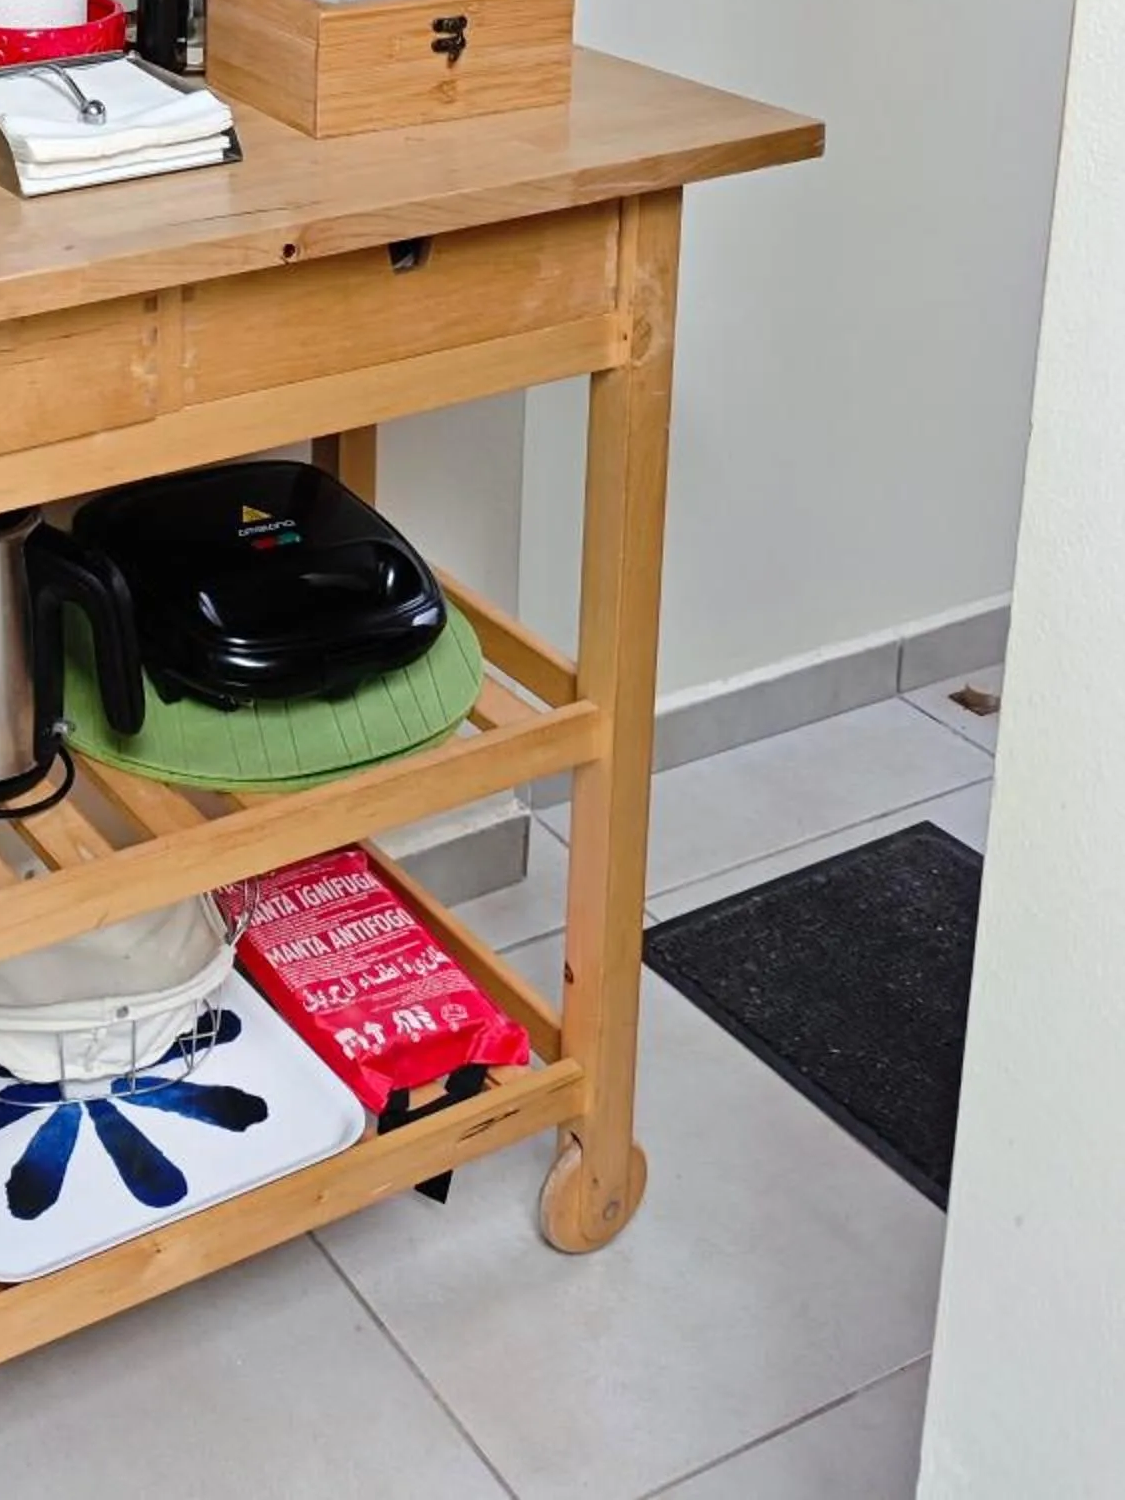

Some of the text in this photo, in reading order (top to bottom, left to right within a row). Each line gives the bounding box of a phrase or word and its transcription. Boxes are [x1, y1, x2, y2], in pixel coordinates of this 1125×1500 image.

[295, 871, 383, 909] IGNÍFUGA
[262, 907, 416, 969] MANTA ANTIFOGO
